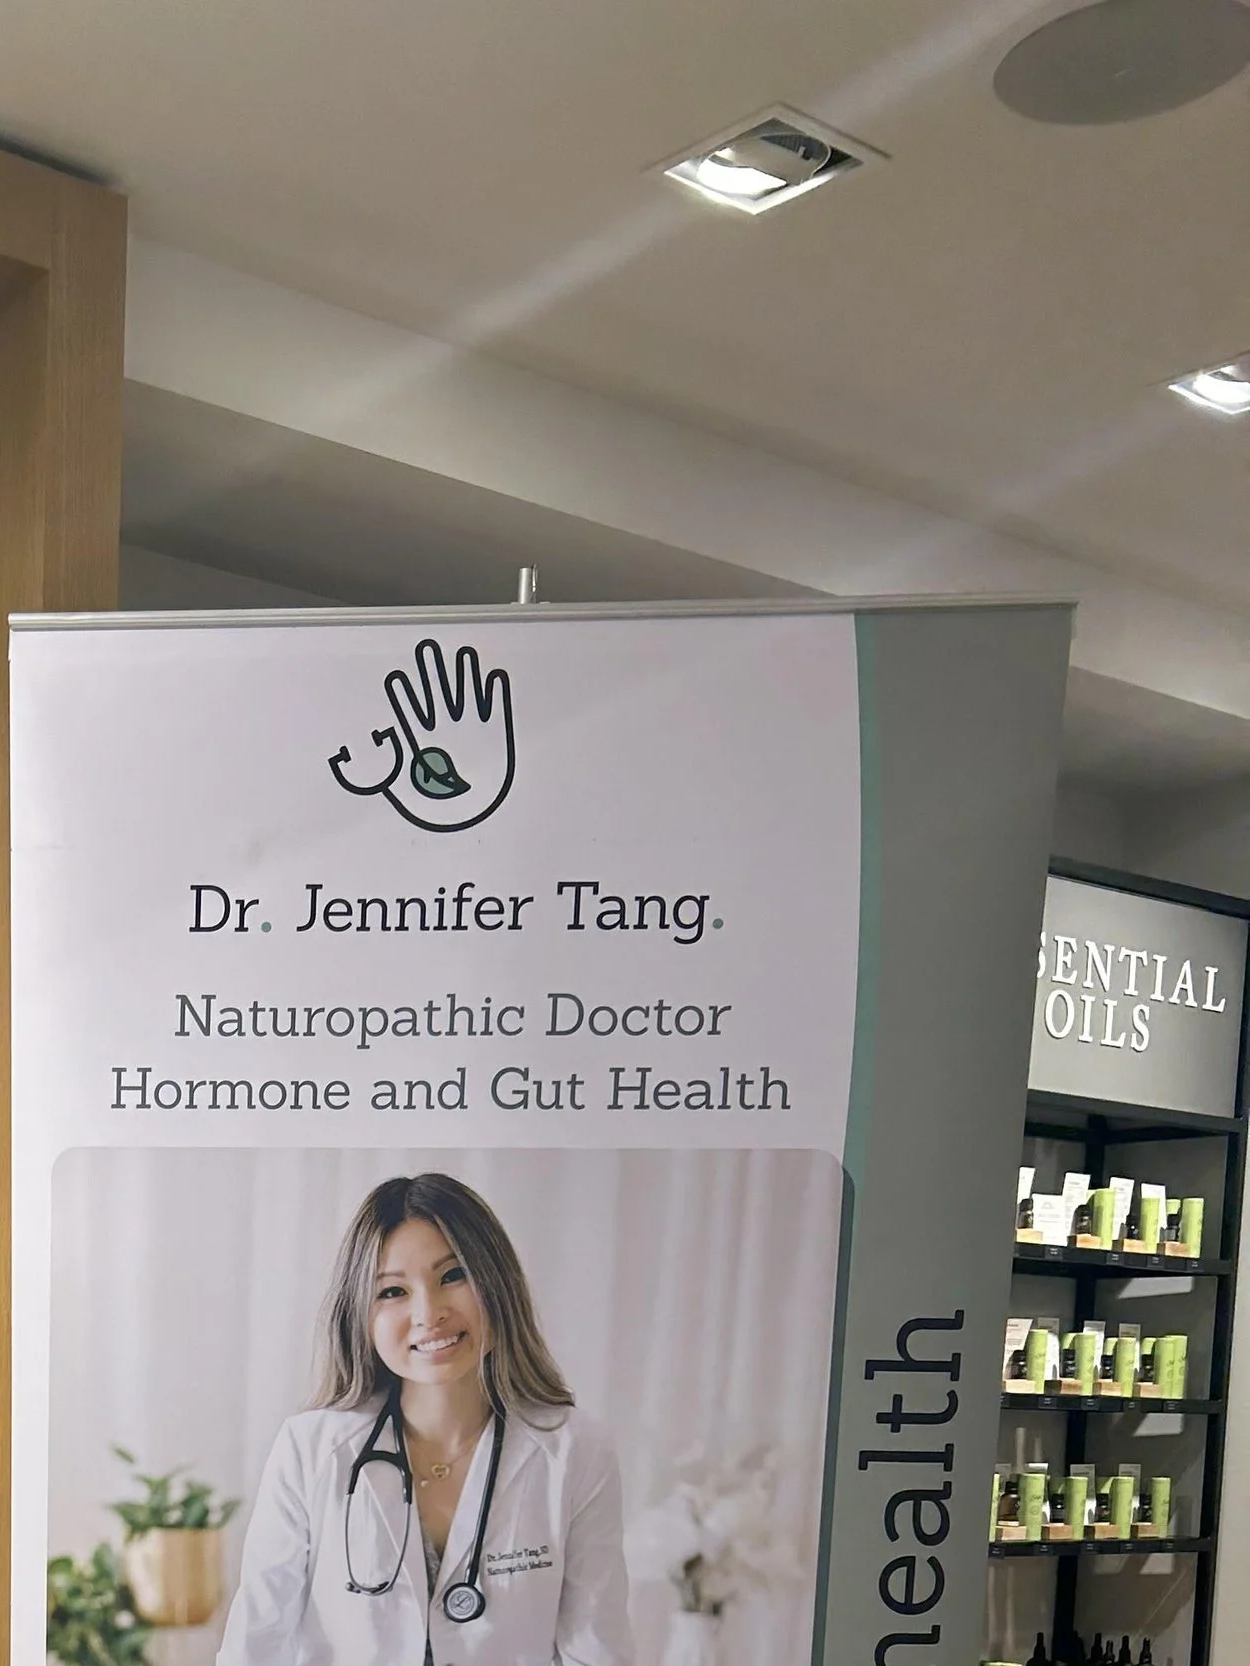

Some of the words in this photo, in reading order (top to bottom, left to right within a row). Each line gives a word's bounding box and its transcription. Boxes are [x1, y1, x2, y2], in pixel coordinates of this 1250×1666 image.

[188, 884, 273, 934] Dr.
[296, 881, 534, 933] Jennifer
[556, 880, 726, 945] Tang.
[174, 993, 526, 1049] Naturopathic
[546, 991, 732, 1037] Doctor
[1045, 989, 1150, 1052] OILS
[110, 1066, 352, 1111] Hormone
[370, 1066, 469, 1111] and
[490, 1066, 586, 1111] Gut
[607, 1066, 792, 1111] Health
